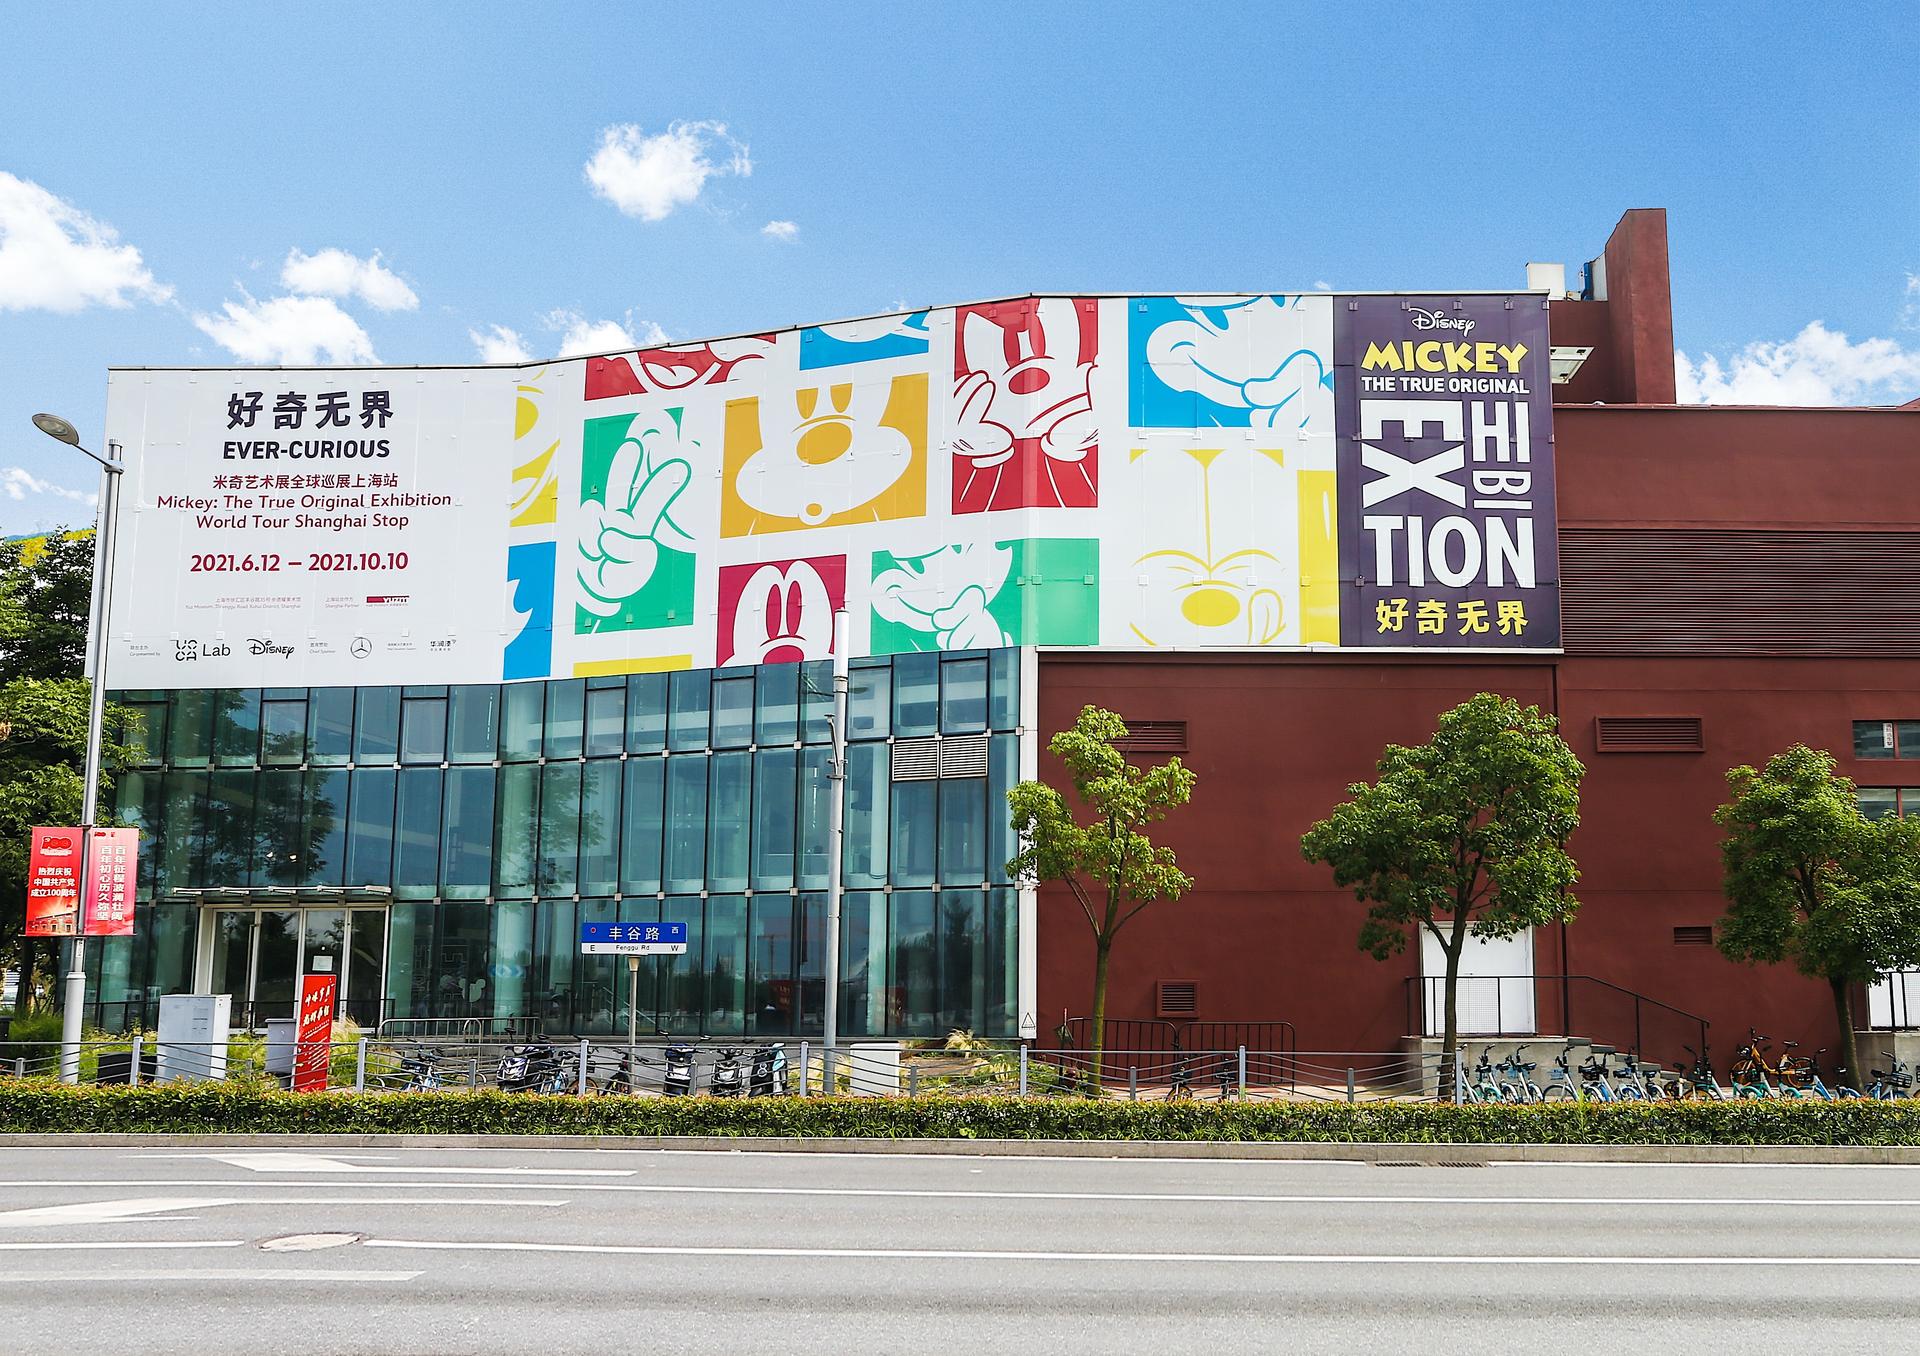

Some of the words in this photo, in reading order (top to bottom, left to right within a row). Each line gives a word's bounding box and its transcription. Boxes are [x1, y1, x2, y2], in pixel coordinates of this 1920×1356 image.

[1361, 341, 1529, 374] MICKEY
[1361, 377, 1396, 392] THE
[1399, 378, 1446, 393] TRUE
[1449, 379, 1530, 394] ORIGINAL
[227, 390, 394, 430] 好奇无界
[223, 440, 390, 460] EVER-CURIOUS
[212, 473, 399, 490] 米奇艺术展全球巡展上海站
[157, 495, 218, 513] Mickey:
[223, 495, 254, 509] The
[258, 495, 296, 509] True
[301, 494, 365, 512] Original
[371, 493, 452, 507] Exhibition
[196, 515, 248, 529] World
[252, 515, 290, 529] Tour
[295, 514, 367, 532] Shanghai
[372, 513, 409, 530] Stop
[190, 554, 281, 572] 2021.6.12
[308, 552, 409, 571] 2021.10.10
[1375, 598, 1529, 636] 好奇无界
[202, 643, 231, 657] Lab
[38, 867, 73, 877] 热烈庆祝
[33, 877, 76, 887] 中国共产党
[30, 888, 77, 898] 成立100周年
[609, 926, 660, 941] 丰谷路
[671, 926, 680, 934] 西
[615, 944, 639, 952] Fenggu
